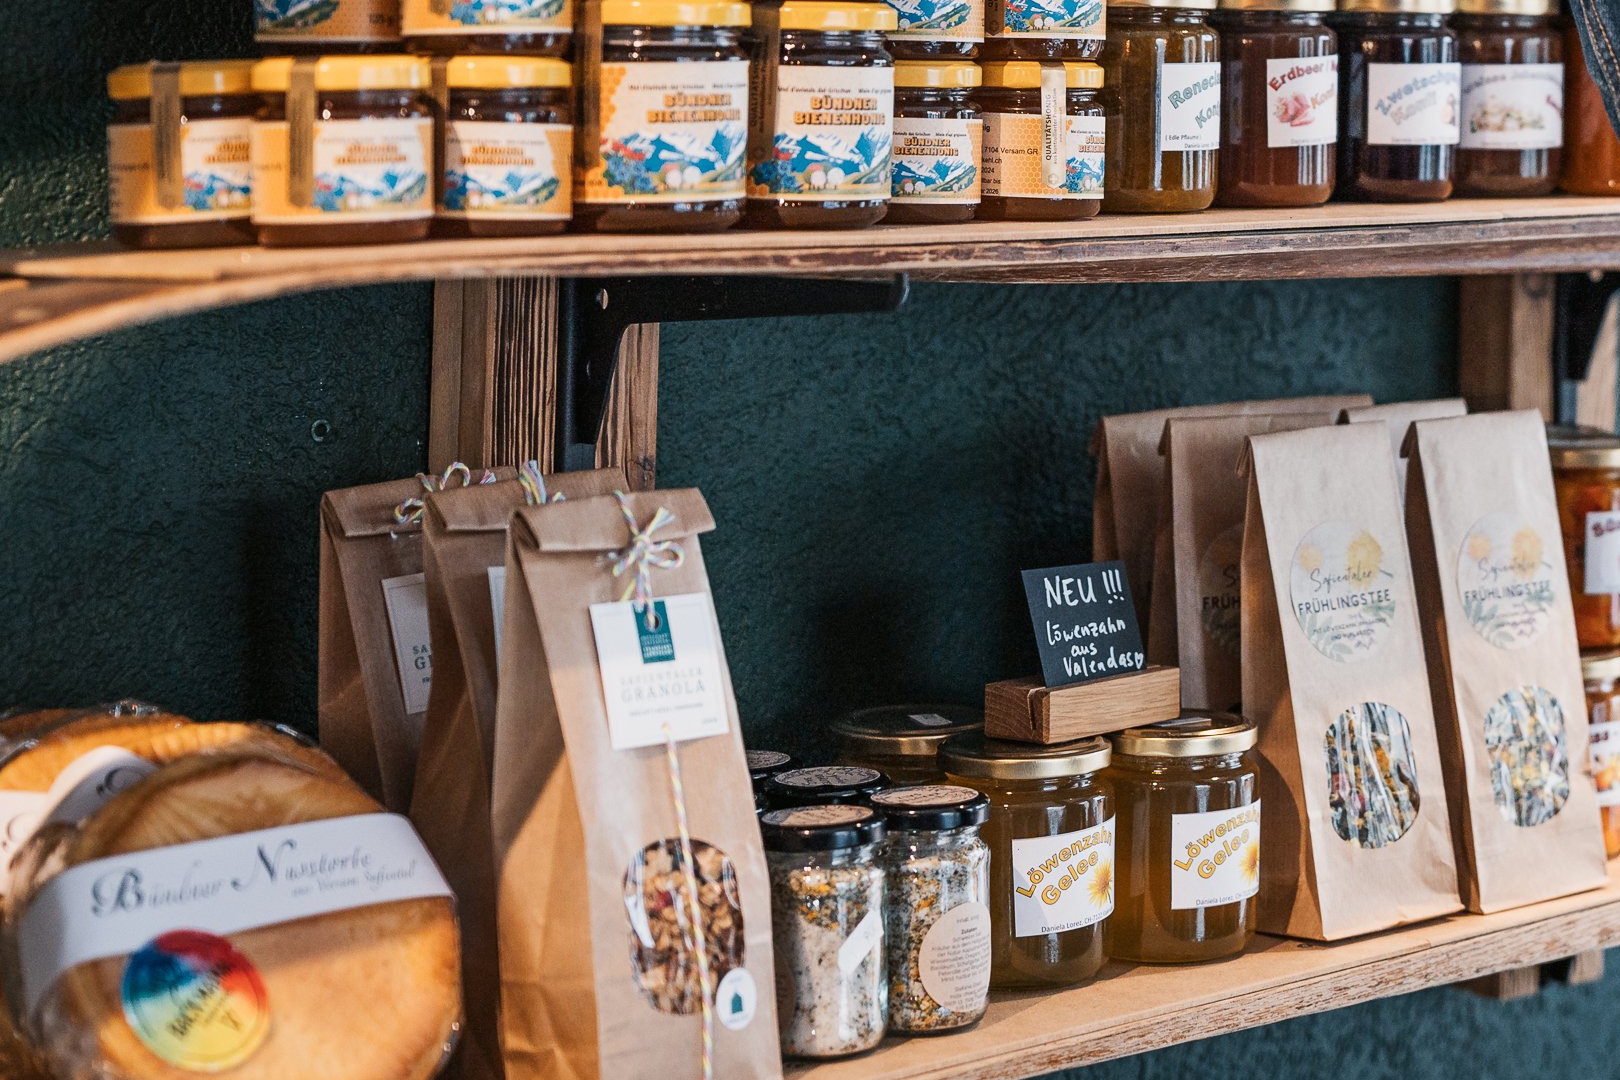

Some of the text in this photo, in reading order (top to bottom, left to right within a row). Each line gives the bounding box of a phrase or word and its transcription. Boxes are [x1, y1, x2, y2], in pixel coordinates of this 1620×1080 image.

[1268, 63, 1324, 92] Erdbeer
[810, 94, 878, 110] BÜNDNER
[1194, 100, 1220, 129] Konf
[893, 146, 959, 157] BIENENHONIG
[903, 136, 951, 148] BÜNDNER
[1000, 147, 1026, 155] Versam
[1026, 148, 1039, 156] GR
[1043, 569, 1125, 609] NEU !!!
[1464, 579, 1550, 602] FRÜHLINGSTEE
[1298, 588, 1391, 616] FRÜHLINGSTEE
[412, 644, 428, 655] SA
[1070, 642, 1098, 656] aus
[1063, 647, 1136, 677] Valendas
[620, 679, 706, 703] GRANOLA
[1016, 826, 1112, 898] Löwenzahn
[1197, 829, 1250, 880] Gelee
[1041, 851, 1099, 905] Gelee
[1196, 897, 1218, 906] Daniela
[1041, 924, 1066, 933] Daniela
